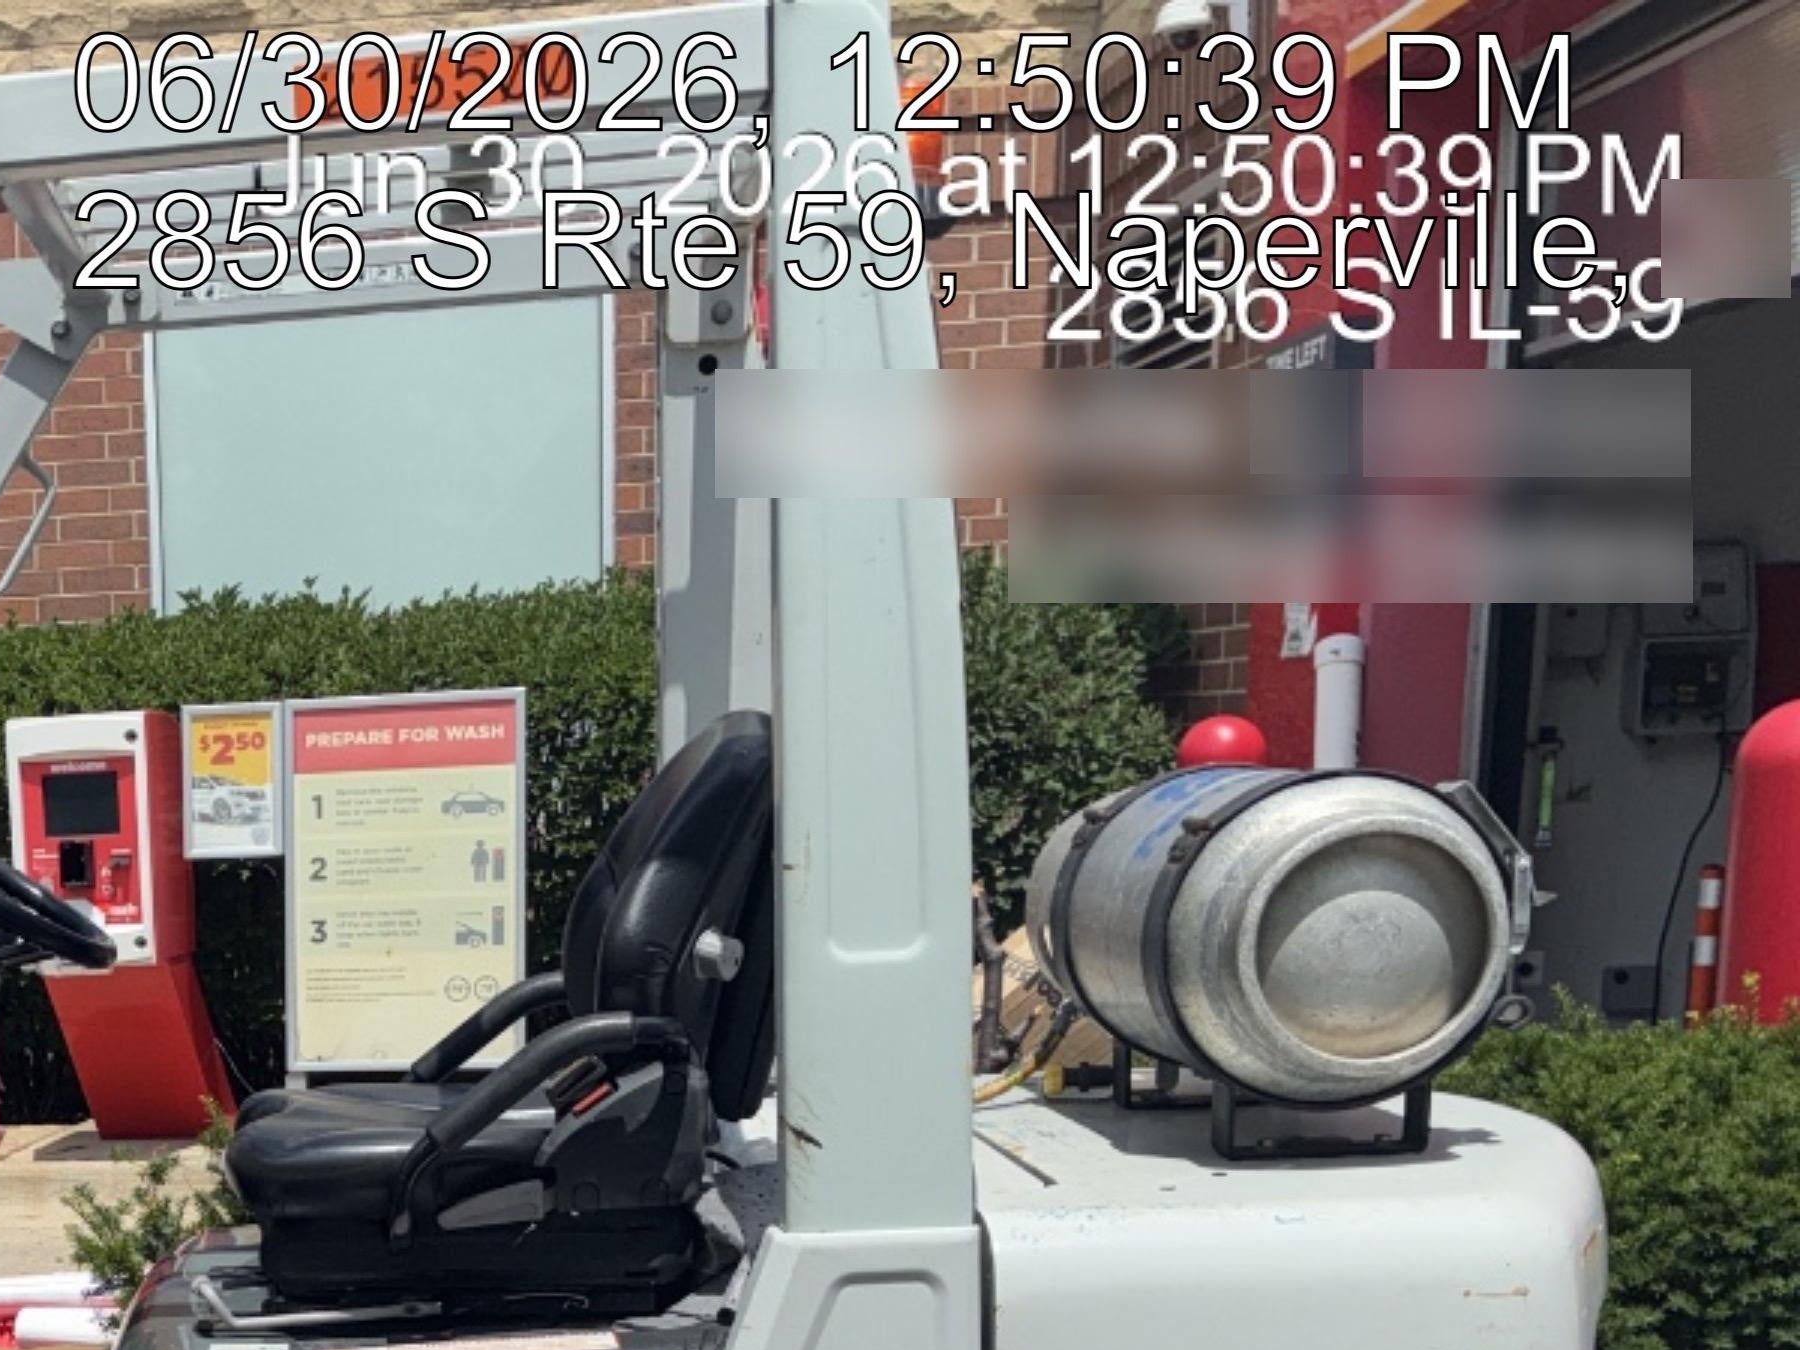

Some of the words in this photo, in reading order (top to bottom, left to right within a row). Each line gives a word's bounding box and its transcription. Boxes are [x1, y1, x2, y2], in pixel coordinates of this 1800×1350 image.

[305, 729, 394, 749] PREPARE
[398, 727, 440, 744] FOR
[444, 723, 505, 741] WASH
[311, 794, 323, 820] 1
[309, 857, 328, 882] 2
[310, 919, 328, 944] 3
